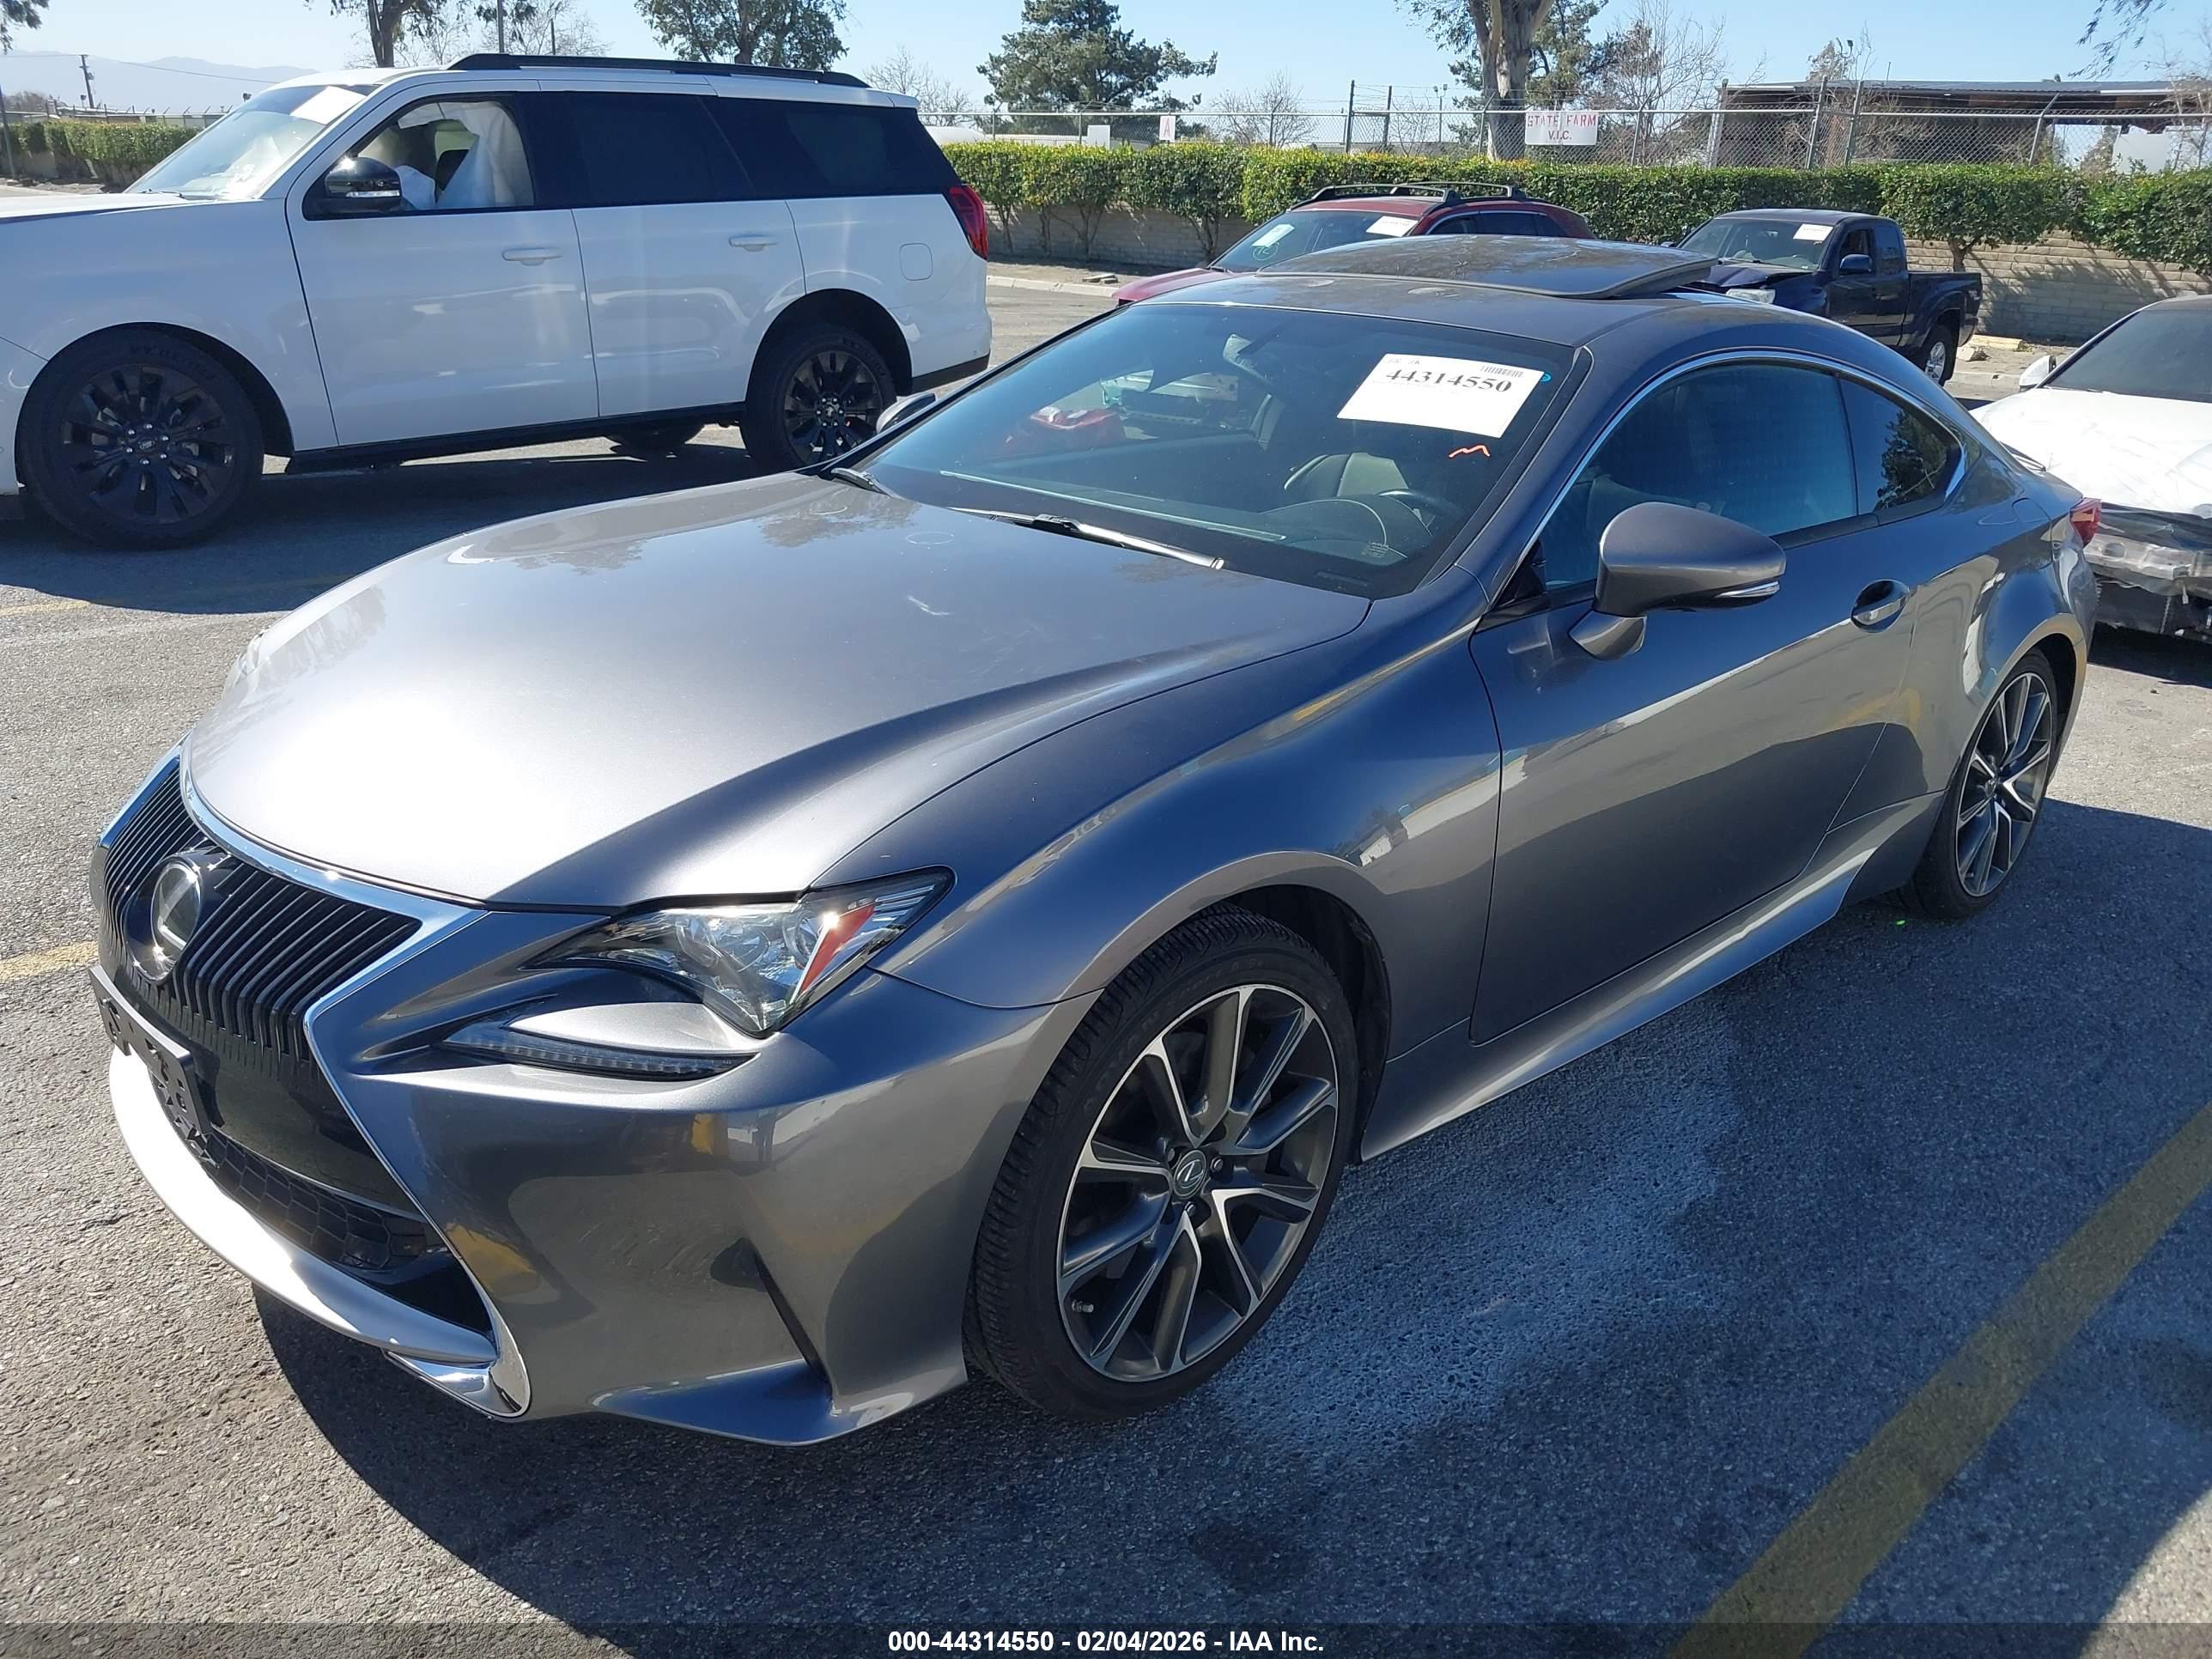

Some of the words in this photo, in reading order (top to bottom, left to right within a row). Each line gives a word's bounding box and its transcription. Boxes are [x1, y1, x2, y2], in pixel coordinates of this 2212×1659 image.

[1164, 117, 1171, 137] A
[1566, 114, 1596, 127] FARM
[1548, 130, 1572, 140] V.I.C.
[1385, 368, 1512, 392] 44314550
